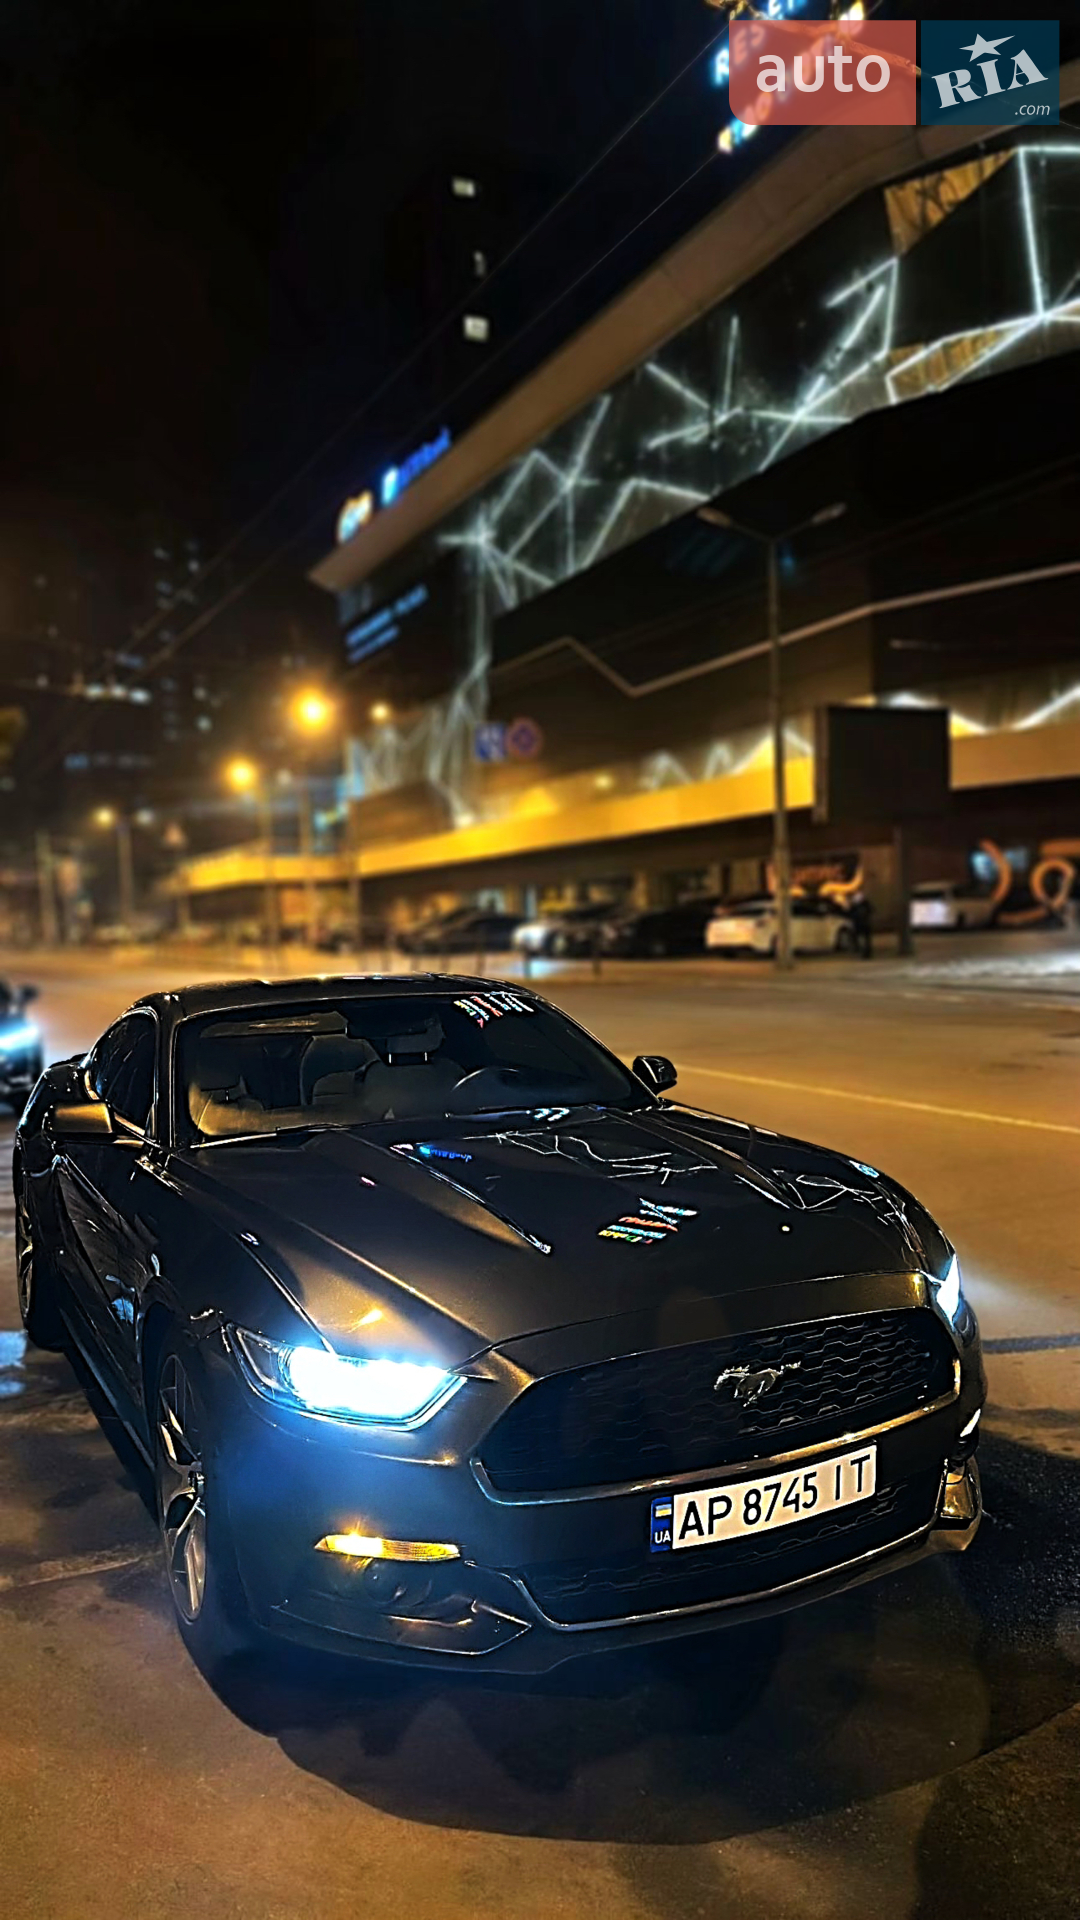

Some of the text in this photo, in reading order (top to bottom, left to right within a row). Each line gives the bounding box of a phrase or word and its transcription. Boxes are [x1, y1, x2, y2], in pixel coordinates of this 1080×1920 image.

[679, 1454, 871, 1540] AP 8745 IT
[654, 1530, 671, 1544] UA
